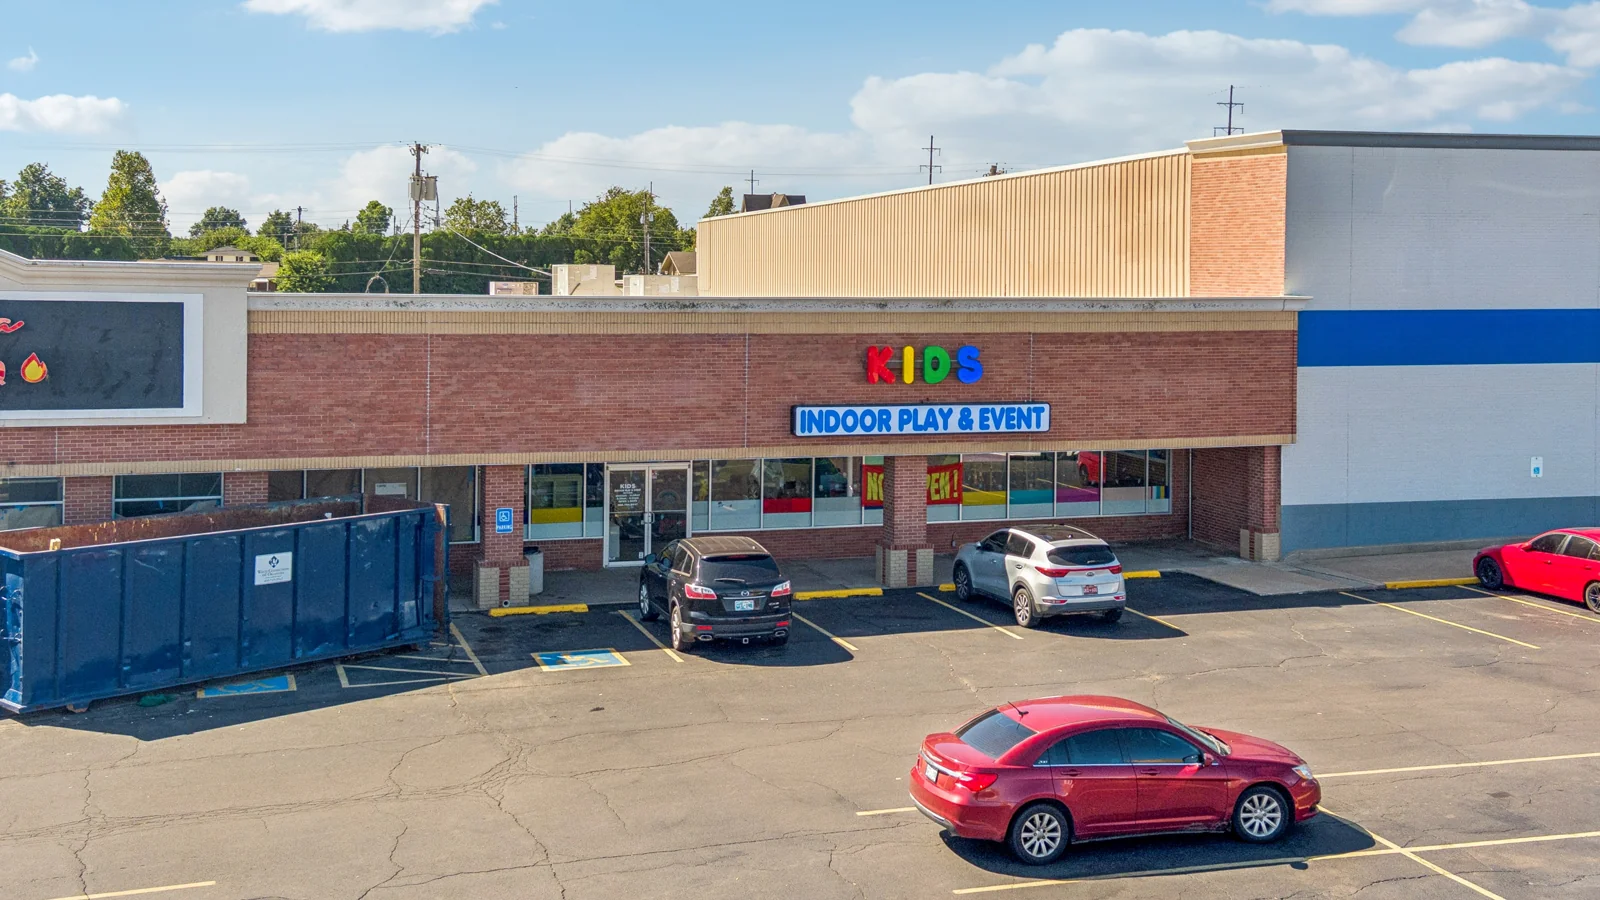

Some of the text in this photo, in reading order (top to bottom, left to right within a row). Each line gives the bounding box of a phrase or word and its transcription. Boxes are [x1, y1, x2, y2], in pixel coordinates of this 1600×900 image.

[867, 345, 983, 384] KIDS
[800, 406, 1045, 433] INDOOR PLAY & EVENT
[867, 472, 884, 501] NO
